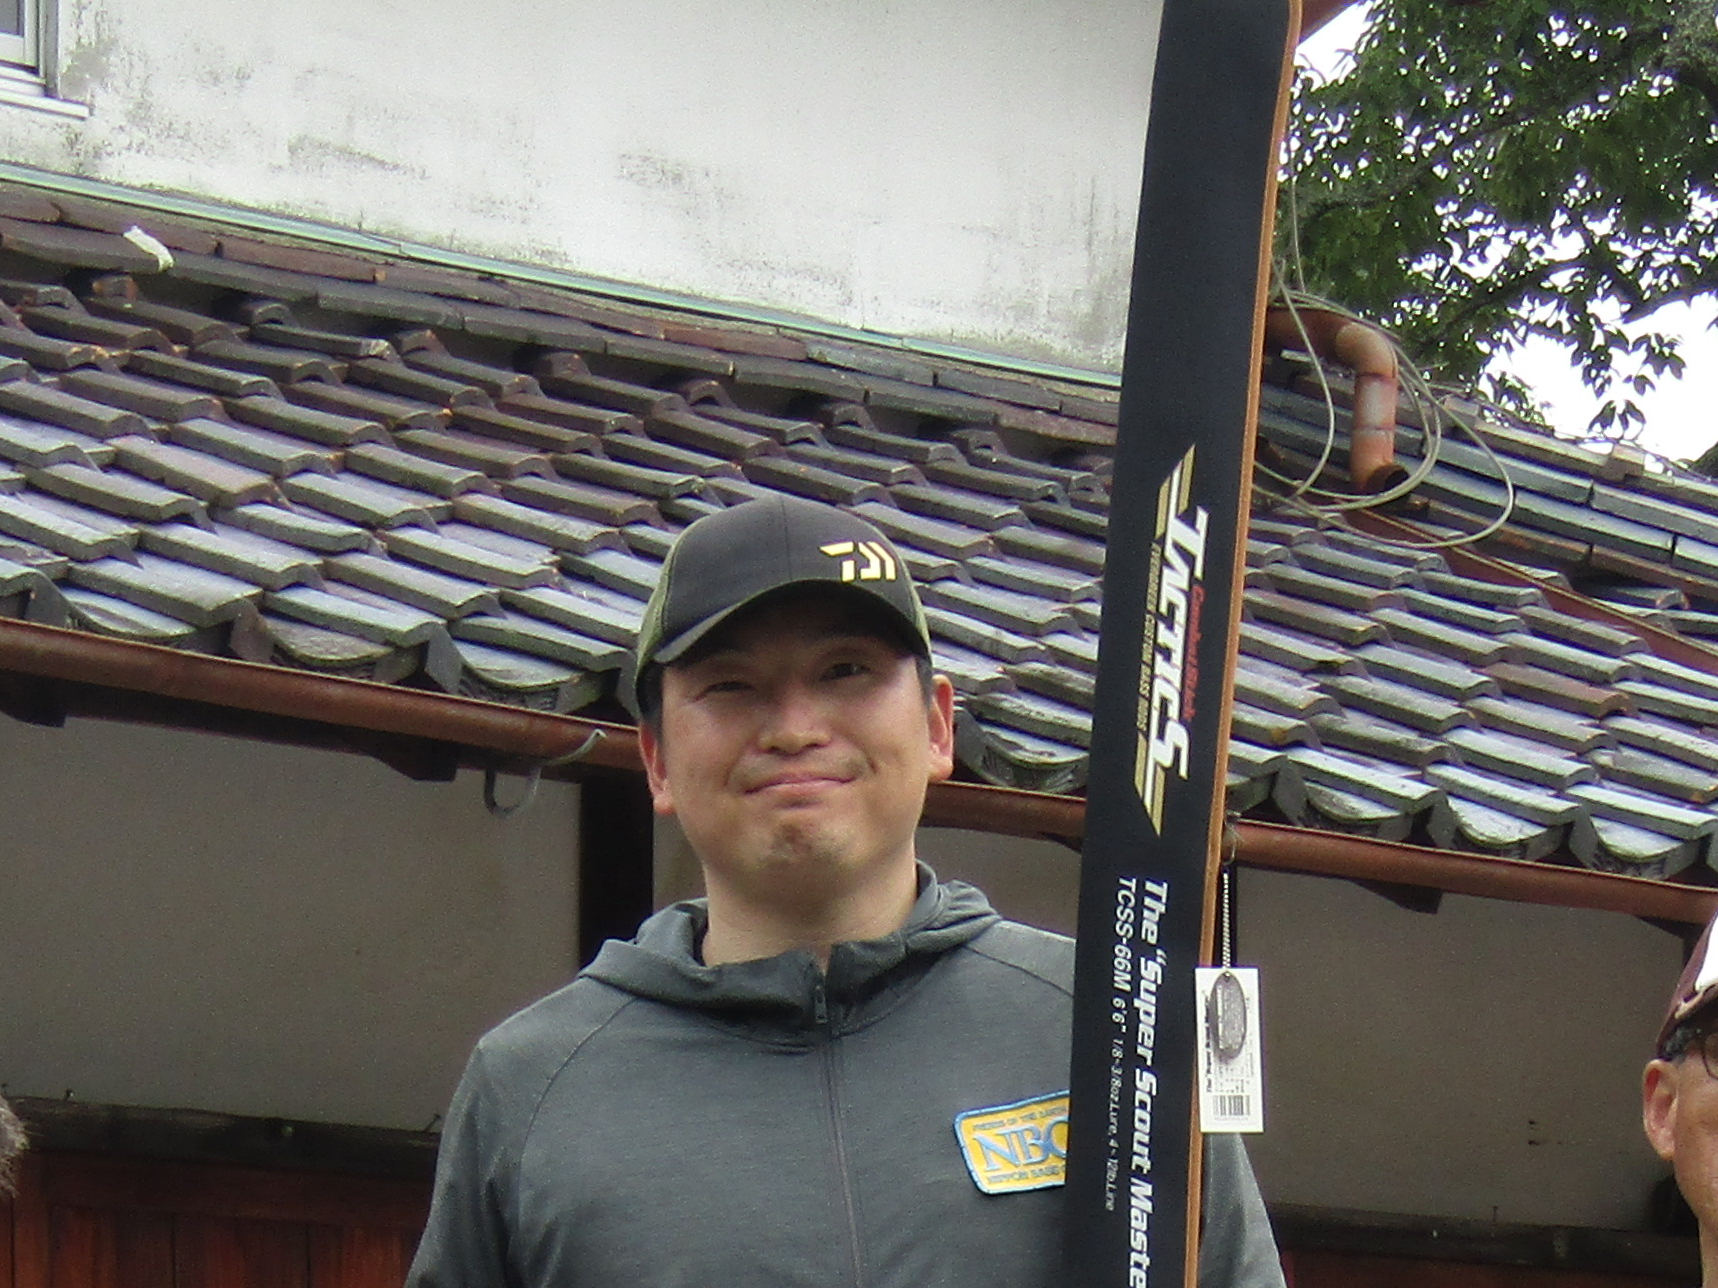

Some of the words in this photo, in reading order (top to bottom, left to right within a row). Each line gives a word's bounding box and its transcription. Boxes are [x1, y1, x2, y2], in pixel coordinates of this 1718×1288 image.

[1152, 506, 1210, 780] TACTICS
[1112, 876, 1136, 992] TCSS-66M
[1141, 879, 1168, 945] The
[1130, 1069, 1158, 1175] Scout
